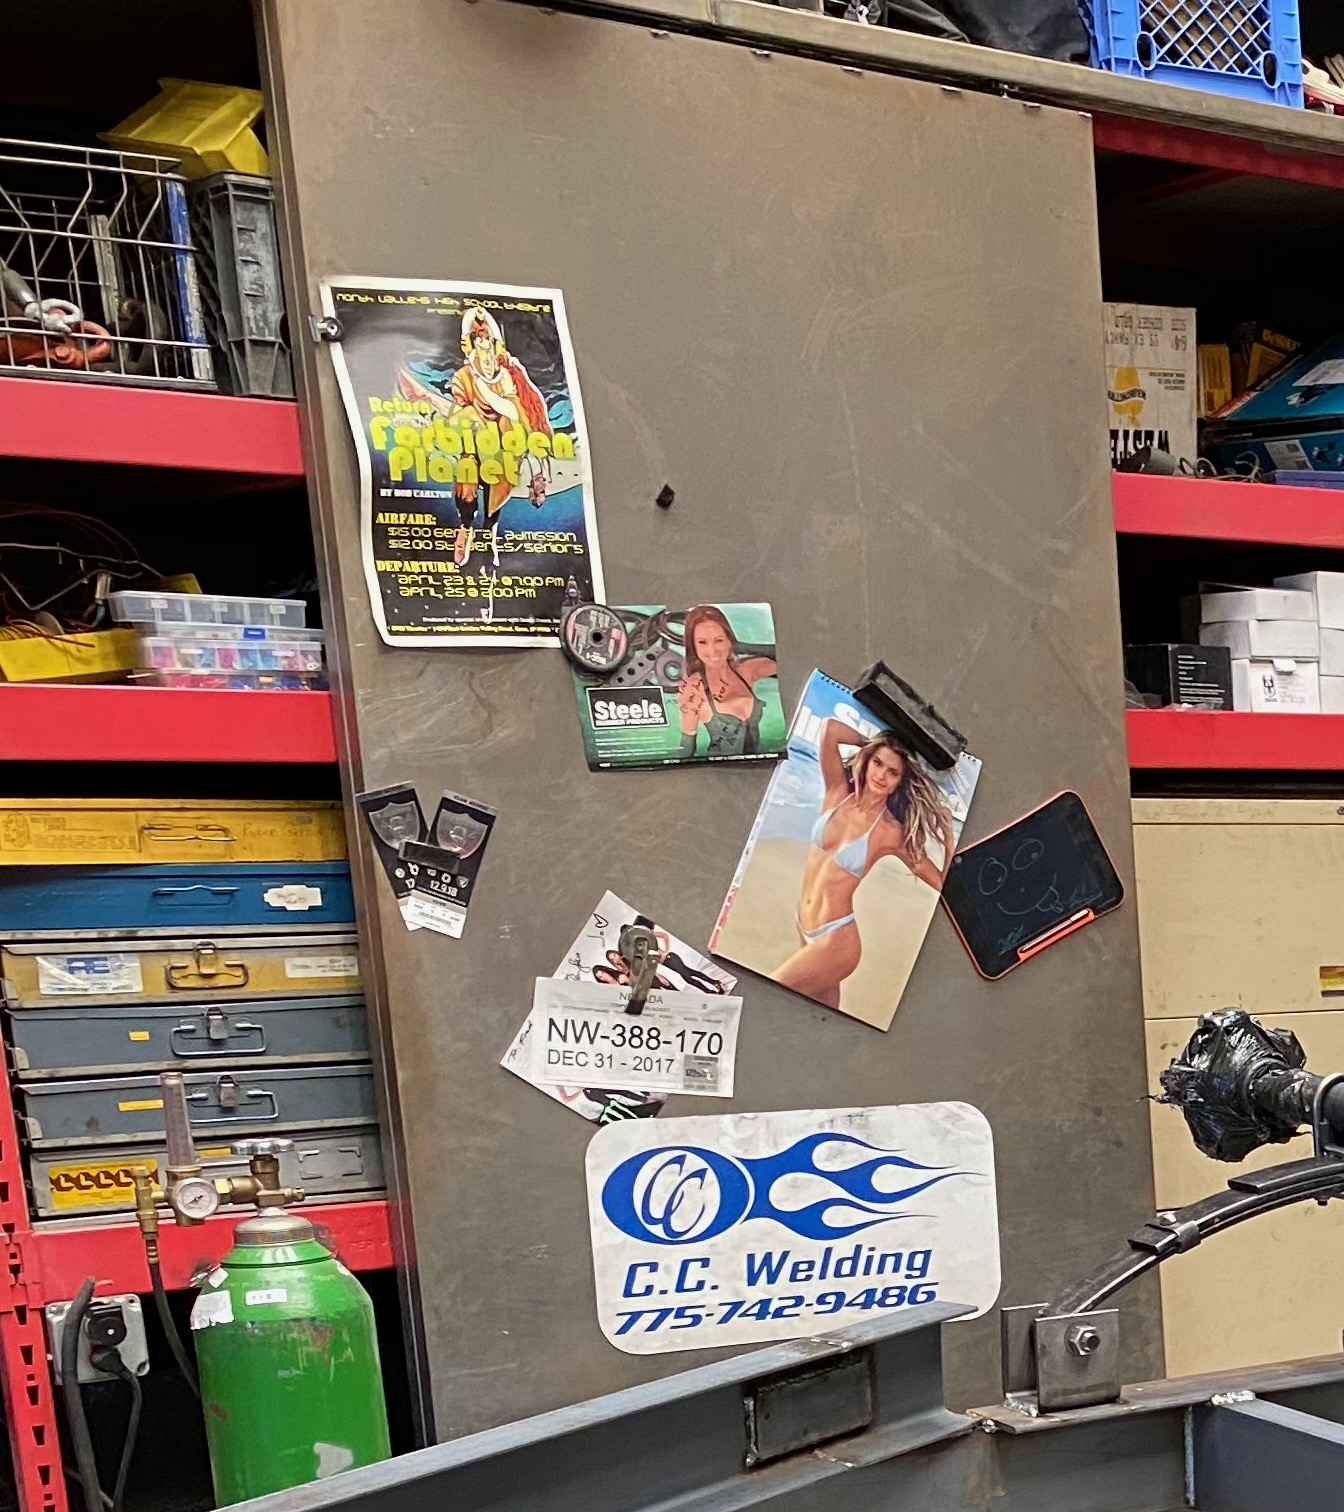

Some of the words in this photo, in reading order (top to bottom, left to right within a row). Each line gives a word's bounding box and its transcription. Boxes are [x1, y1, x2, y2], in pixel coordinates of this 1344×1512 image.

[368, 396, 431, 415] Return
[369, 415, 576, 459] Forbidden
[388, 446, 520, 486] Planet
[375, 512, 437, 525] AIRFARE:
[376, 560, 460, 573] DEPARTURE:
[594, 699, 663, 720] Steele
[547, 1017, 723, 1056] NW-388-170
[547, 1049, 589, 1067] DEC
[594, 1053, 613, 1069] 31
[633, 1056, 675, 1074] 2017
[622, 1256, 718, 1298] C.C.
[746, 1244, 932, 1287] Welding
[614, 1282, 939, 1336] 775-742-9486
